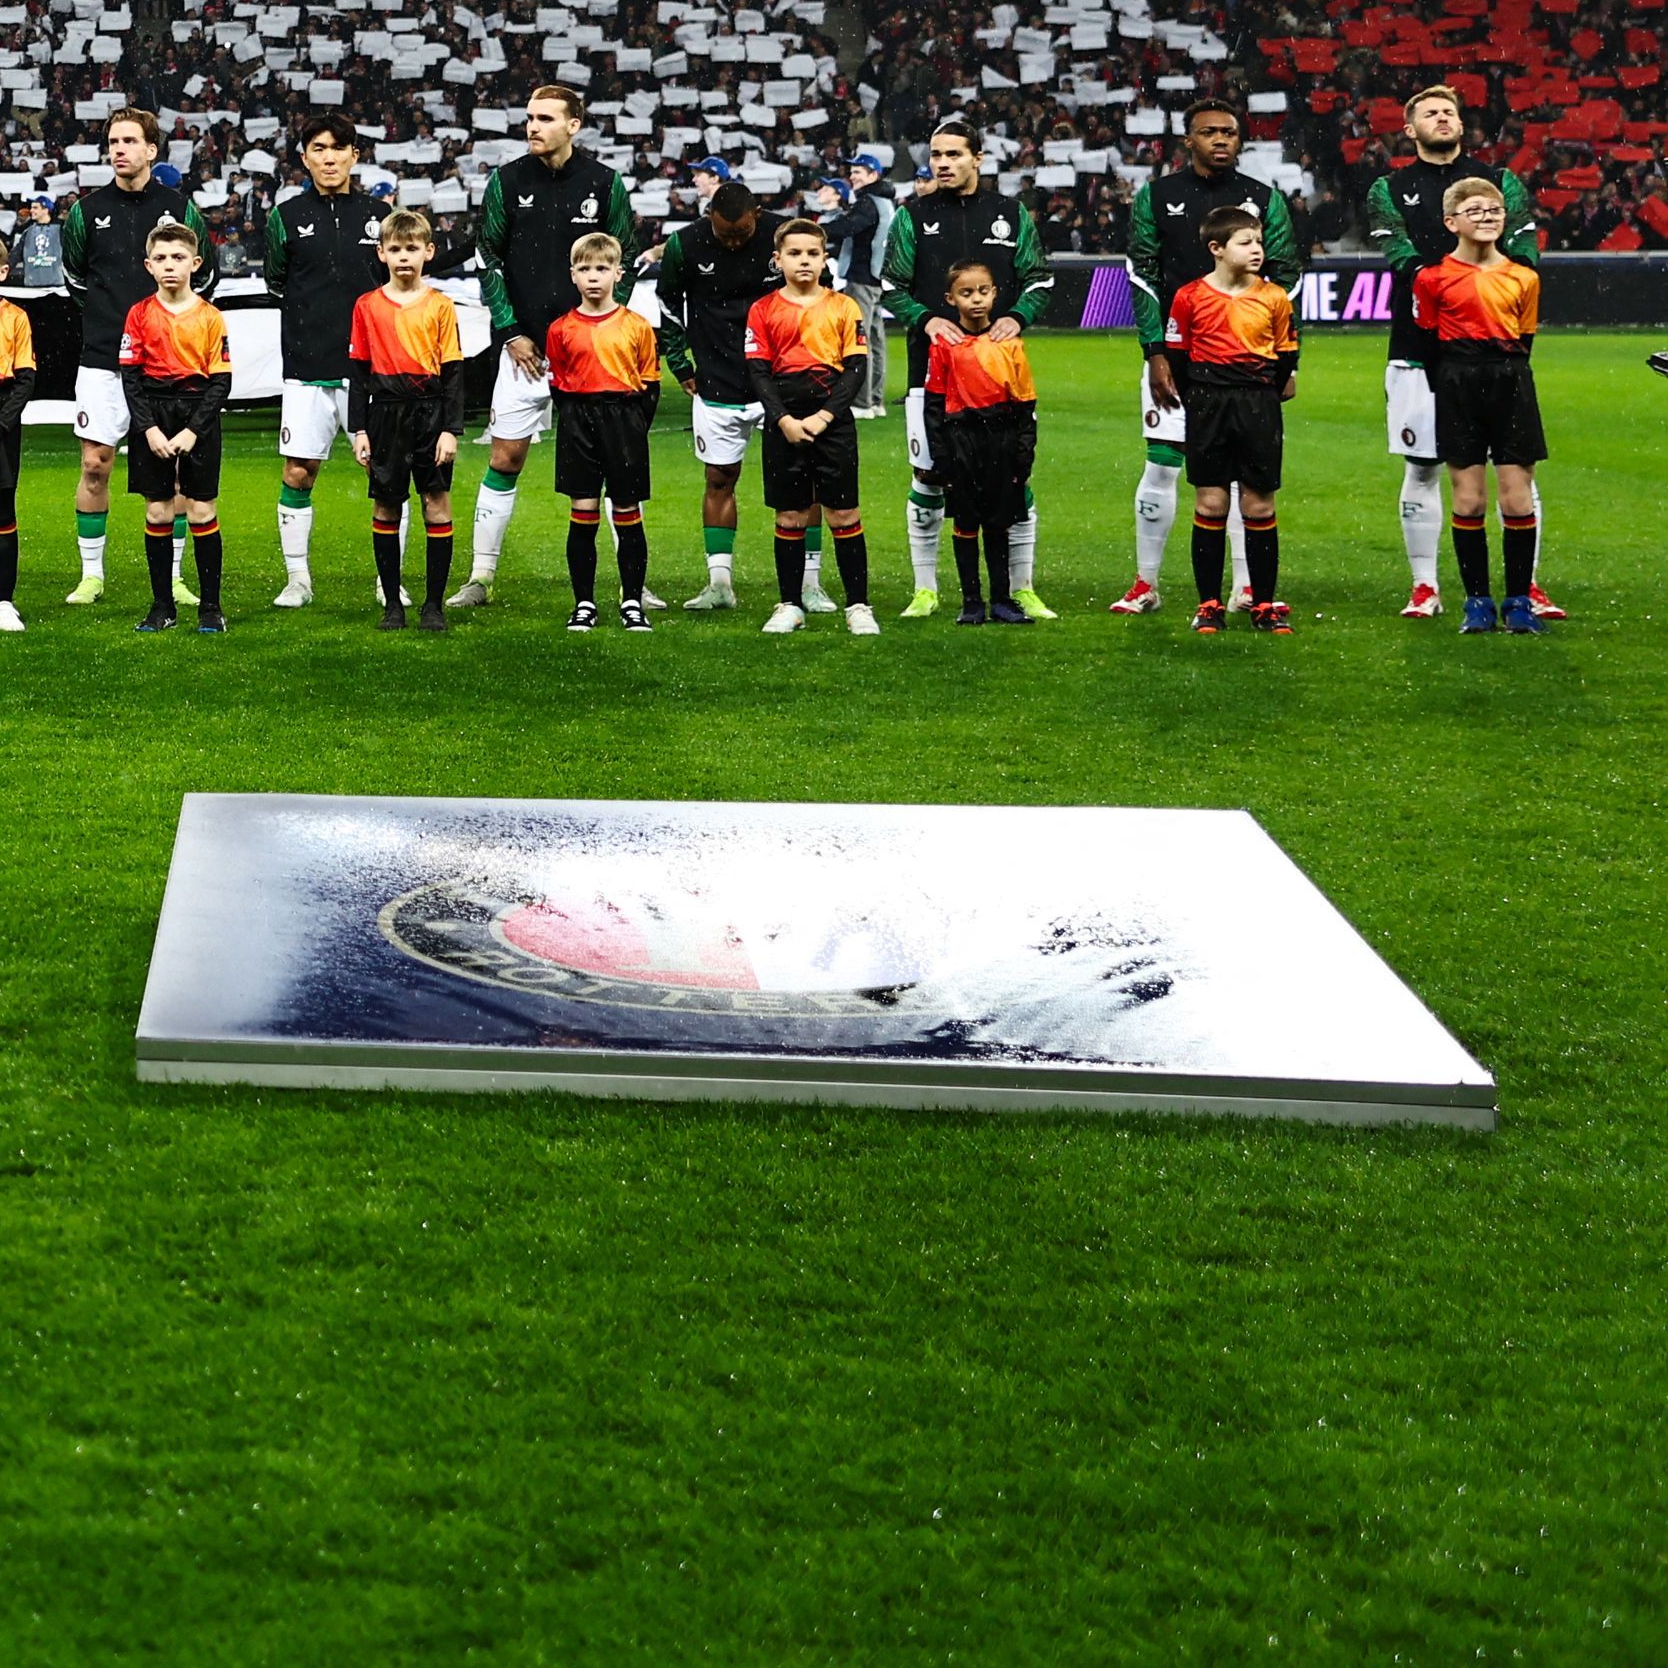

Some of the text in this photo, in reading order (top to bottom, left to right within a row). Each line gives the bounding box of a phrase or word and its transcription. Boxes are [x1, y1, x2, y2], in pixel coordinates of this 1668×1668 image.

[1342, 272, 1392, 320] AL
[474, 507, 493, 523] F
[912, 507, 932, 524] F
[1138, 499, 1160, 517] F
[1401, 500, 1423, 519] F
